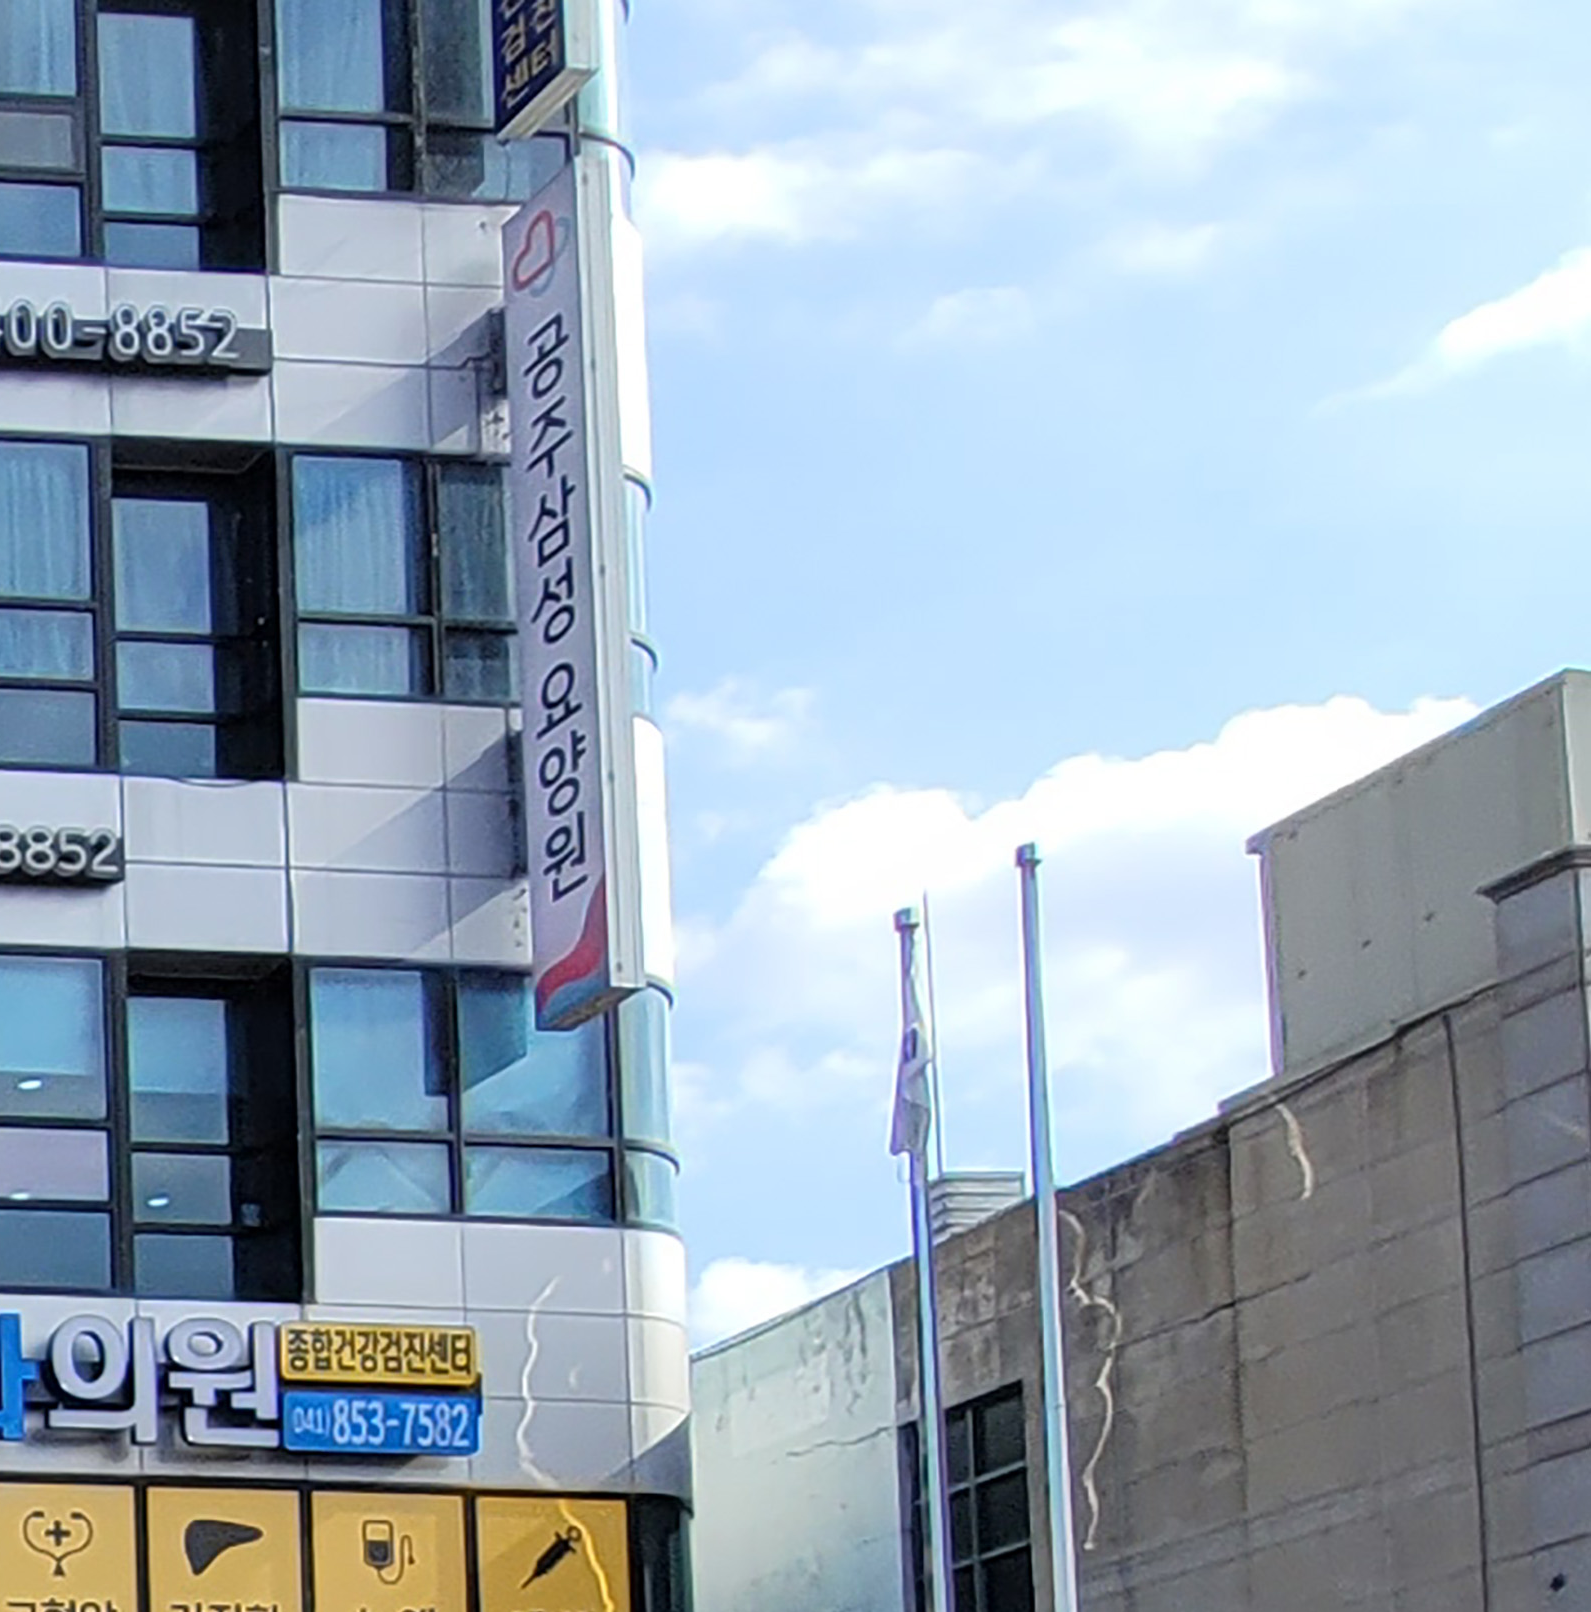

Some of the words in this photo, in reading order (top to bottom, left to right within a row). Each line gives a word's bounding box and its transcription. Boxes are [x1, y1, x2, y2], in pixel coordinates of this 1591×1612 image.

[522, 312, 575, 646] 공주삼성
[537, 662, 589, 902] 요양원
[288, 1328, 471, 1375] 종합건강검진센터
[333, 1399, 470, 1447] 853-7582
